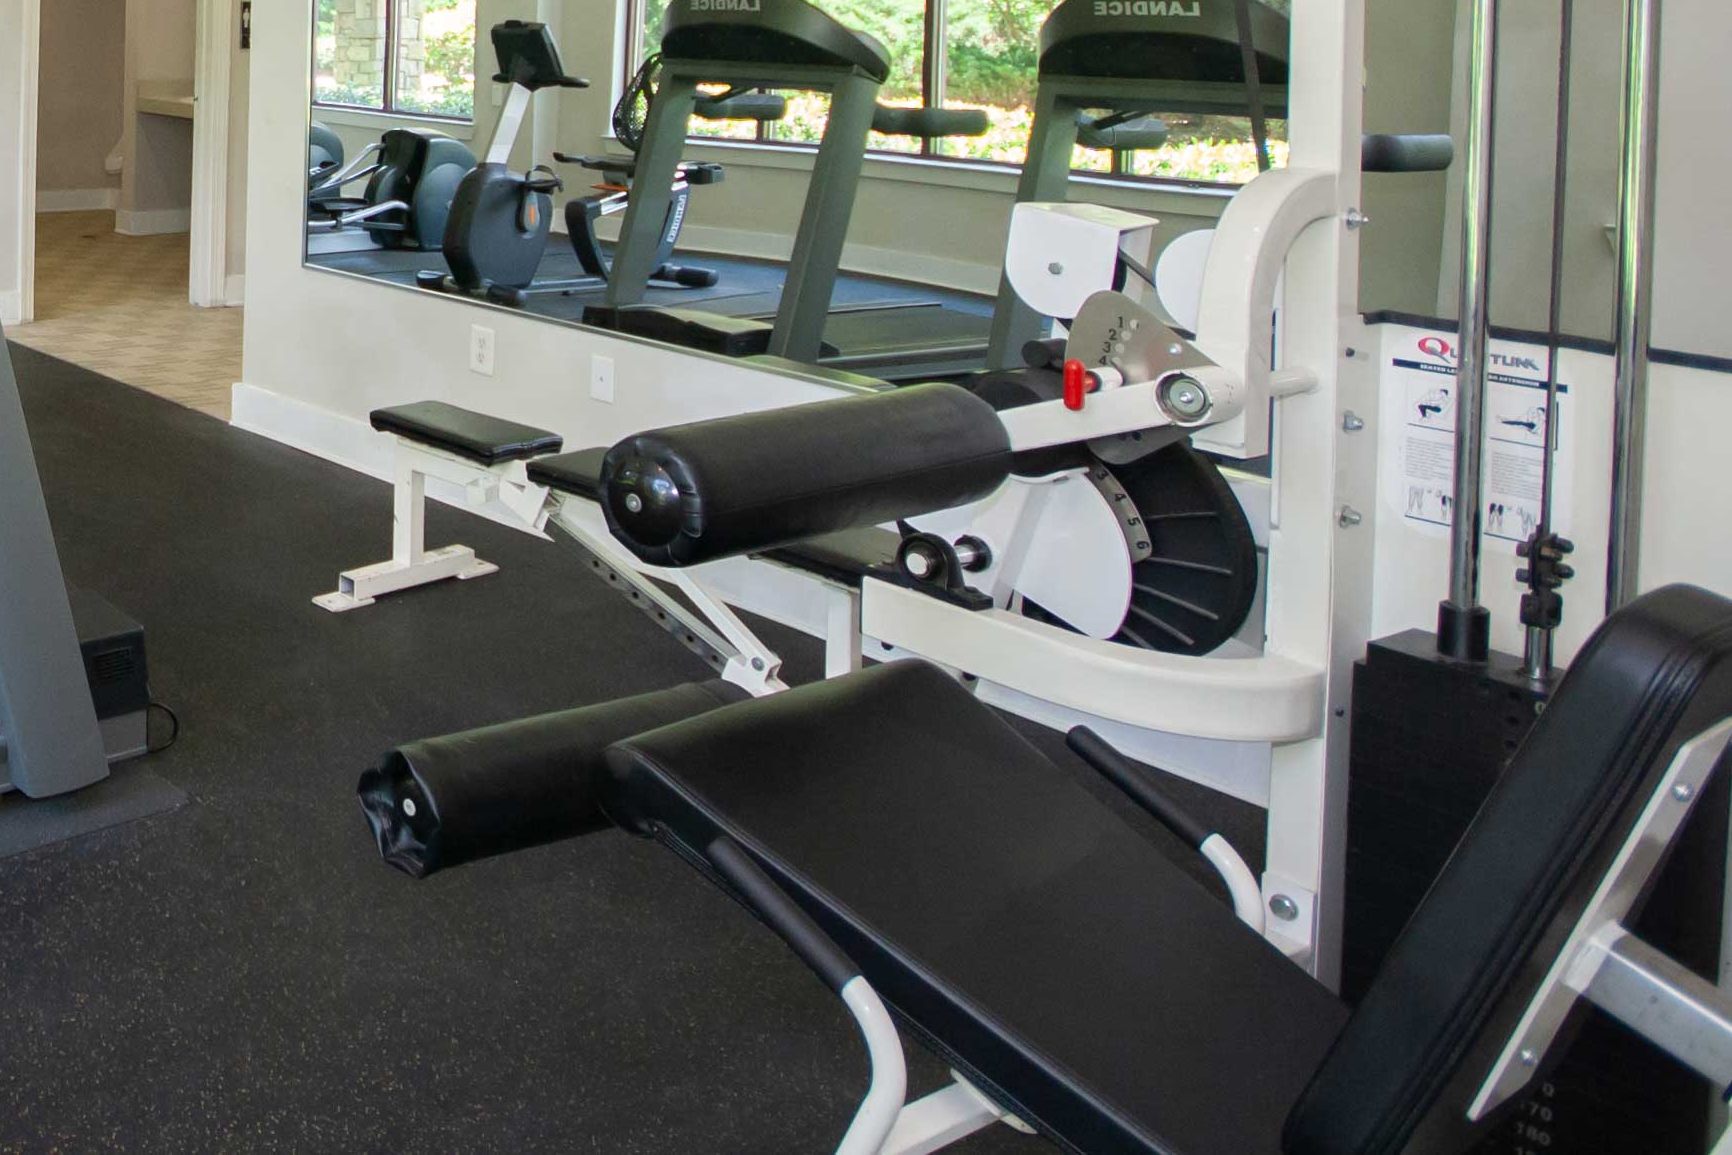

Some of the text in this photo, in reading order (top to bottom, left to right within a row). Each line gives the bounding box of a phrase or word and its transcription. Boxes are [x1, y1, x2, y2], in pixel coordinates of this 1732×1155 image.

[1118, 316, 1124, 328] 1
[1108, 328, 1117, 340] 2
[1102, 341, 1111, 353] 3
[1096, 469, 1109, 480] 3
[1115, 493, 1126, 502] 4
[1127, 517, 1140, 526] 5
